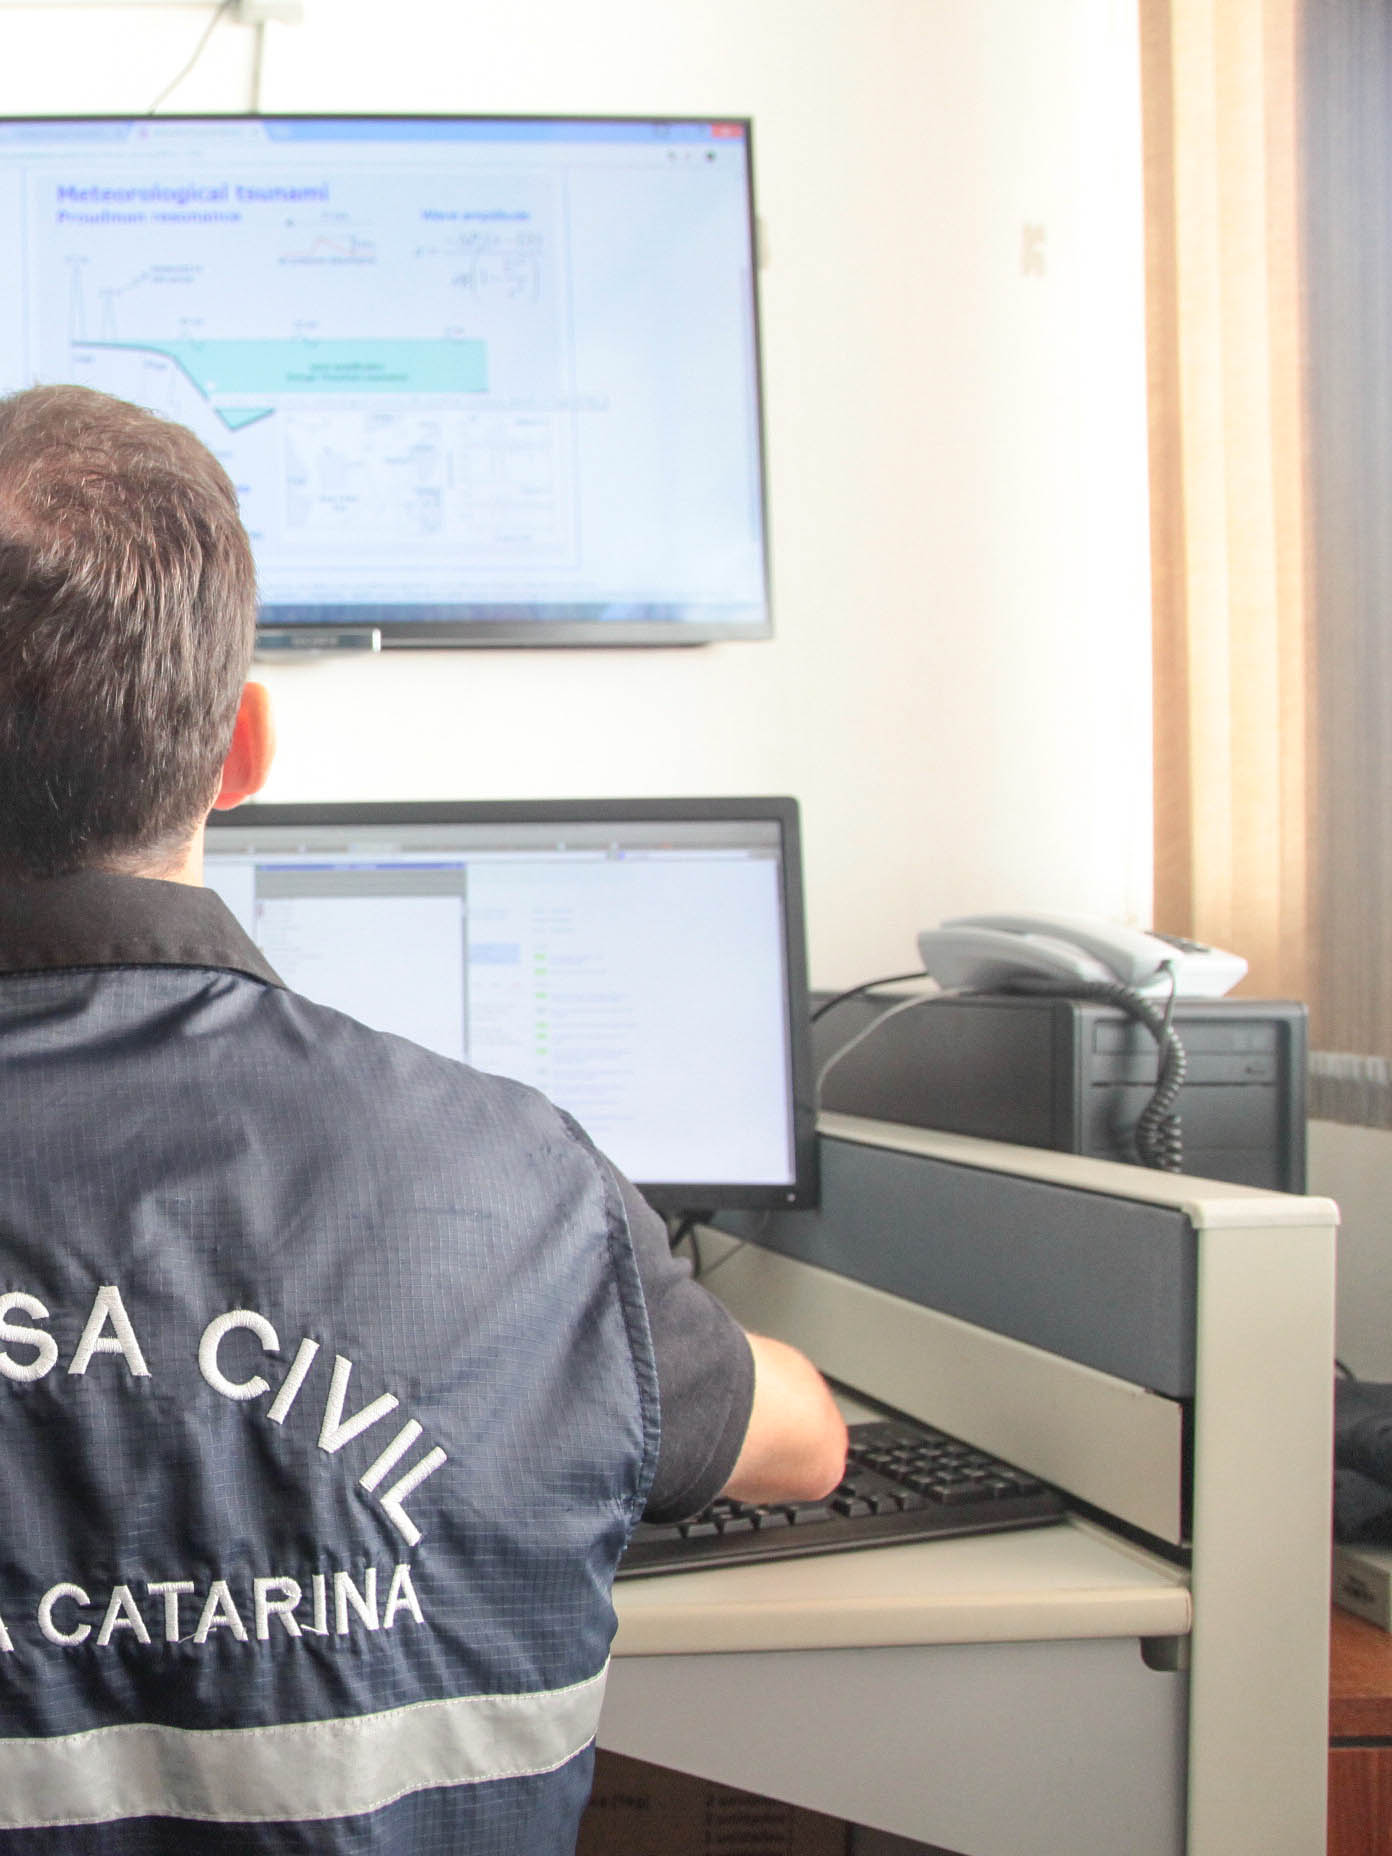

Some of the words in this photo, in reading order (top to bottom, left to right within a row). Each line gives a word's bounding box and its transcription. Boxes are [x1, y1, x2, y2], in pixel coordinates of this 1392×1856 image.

[57, 183, 229, 205] Meteorological
[235, 183, 329, 202] tsunami
[198, 1309, 448, 1546] CIVIL
[37, 1563, 425, 1647] CATARINA
